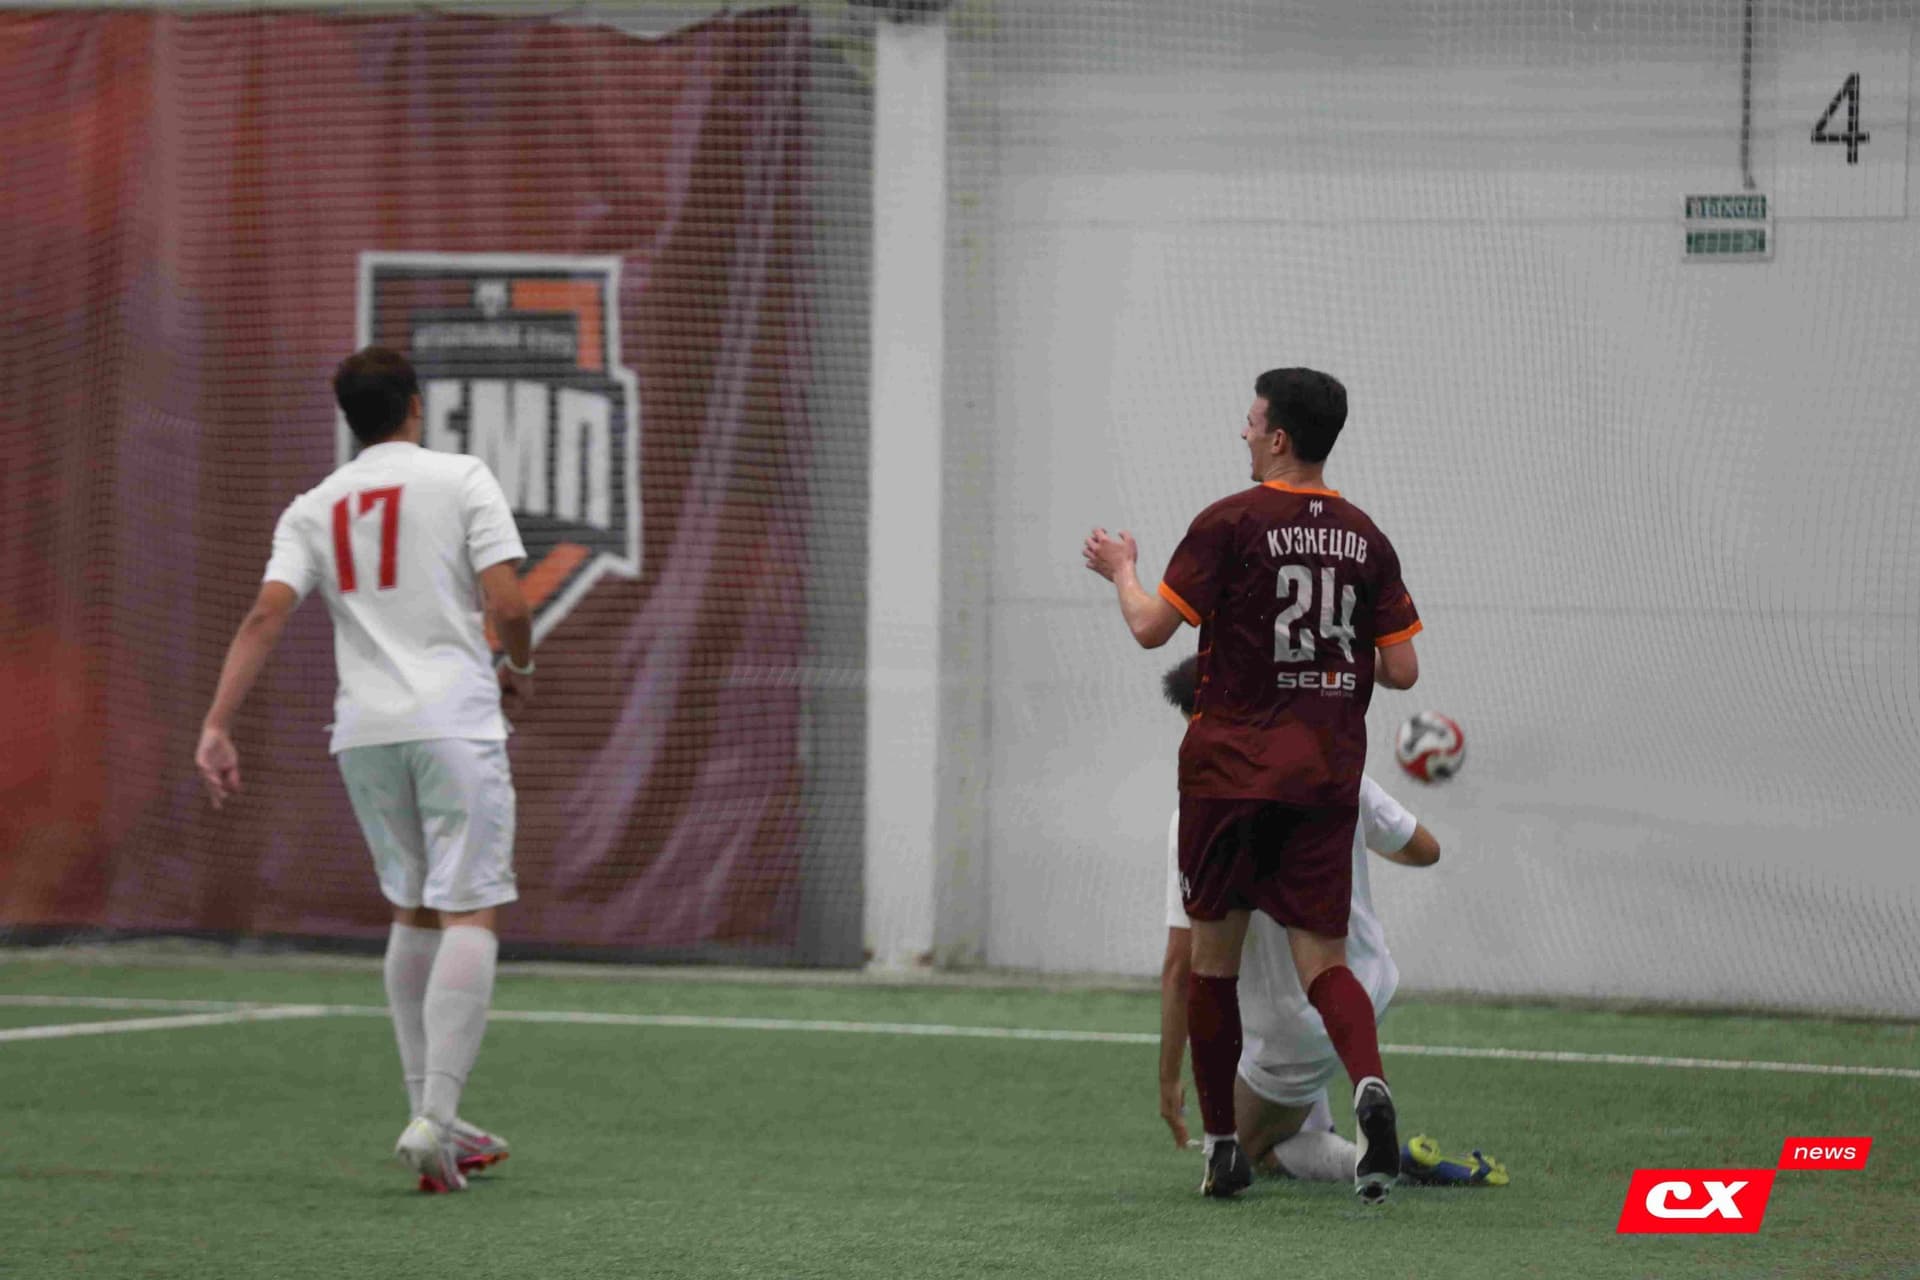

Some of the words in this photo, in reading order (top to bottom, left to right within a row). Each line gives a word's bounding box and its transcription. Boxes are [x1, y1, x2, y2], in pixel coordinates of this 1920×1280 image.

[1811, 72, 1869, 164] 4
[425, 378, 612, 531] ЕМП
[332, 485, 404, 593] 17
[1267, 526, 1368, 564] КУЗНЕЦОВ
[1274, 564, 1357, 664] 24
[1277, 671, 1357, 690] SEUS
